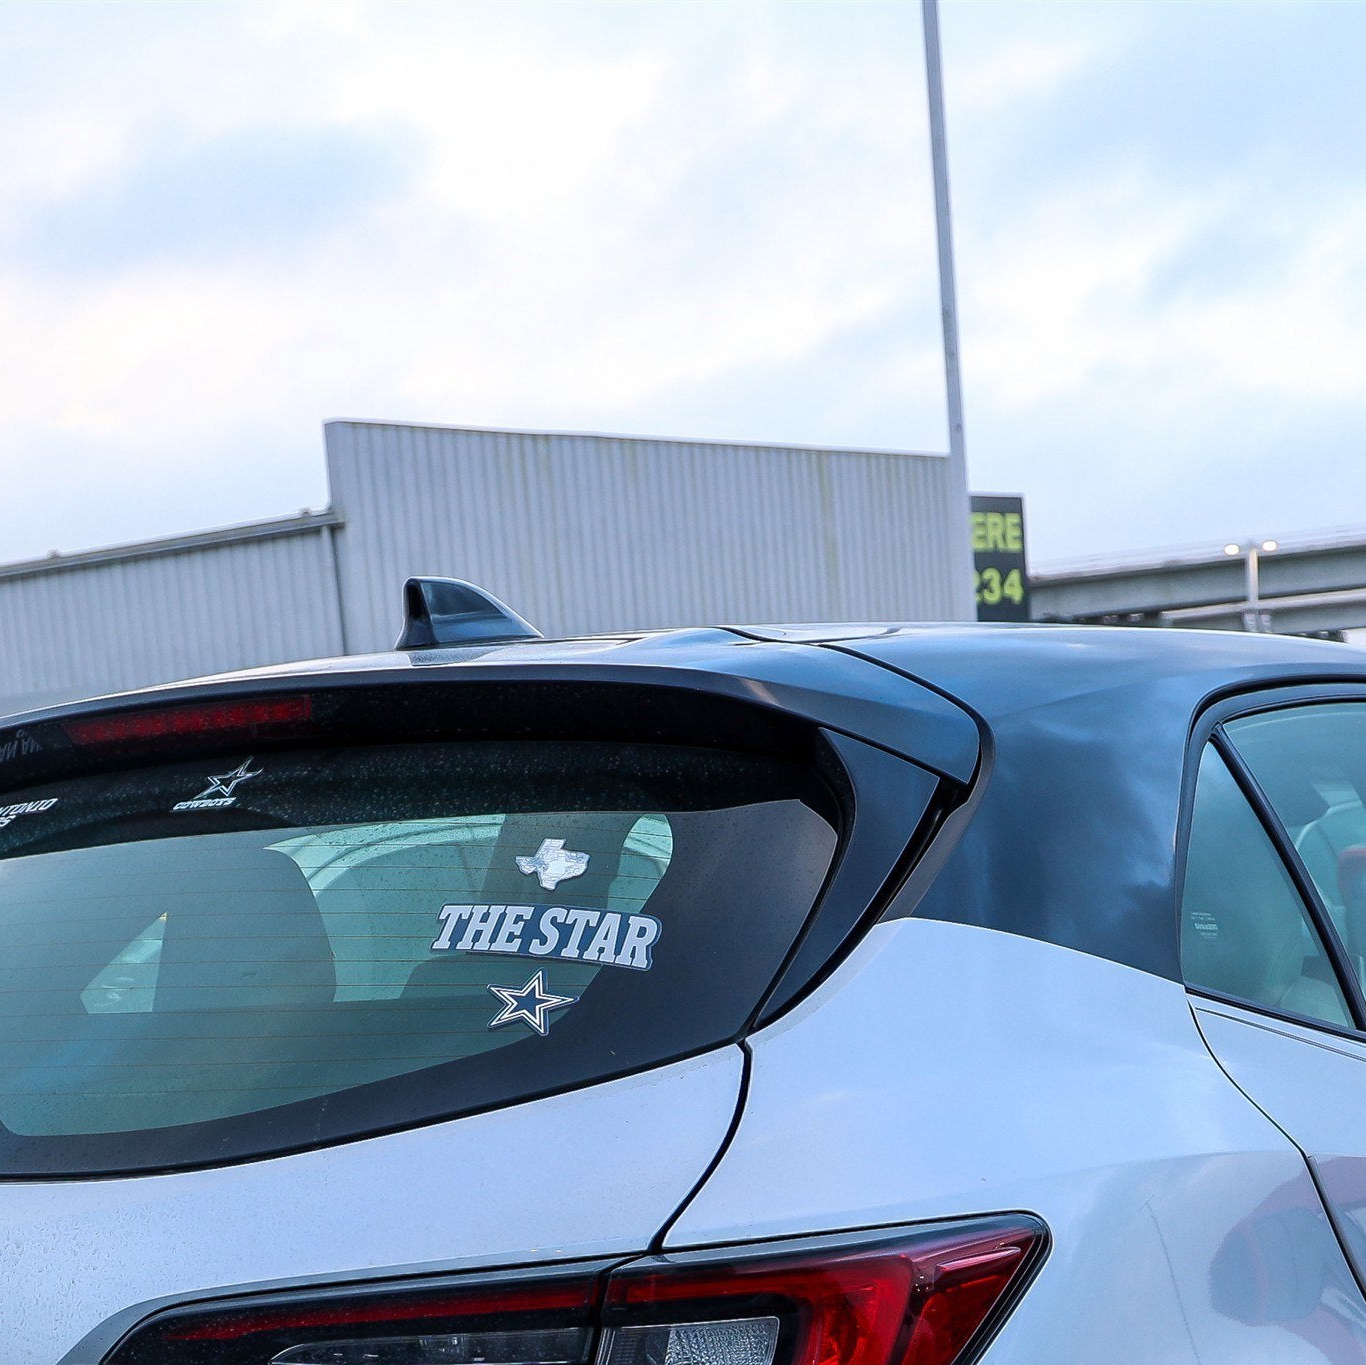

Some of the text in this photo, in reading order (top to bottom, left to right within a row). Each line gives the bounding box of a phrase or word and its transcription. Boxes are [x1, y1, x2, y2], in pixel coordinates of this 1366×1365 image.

[172, 797, 237, 811] COWBOYS
[431, 904, 659, 970] THE STAR
